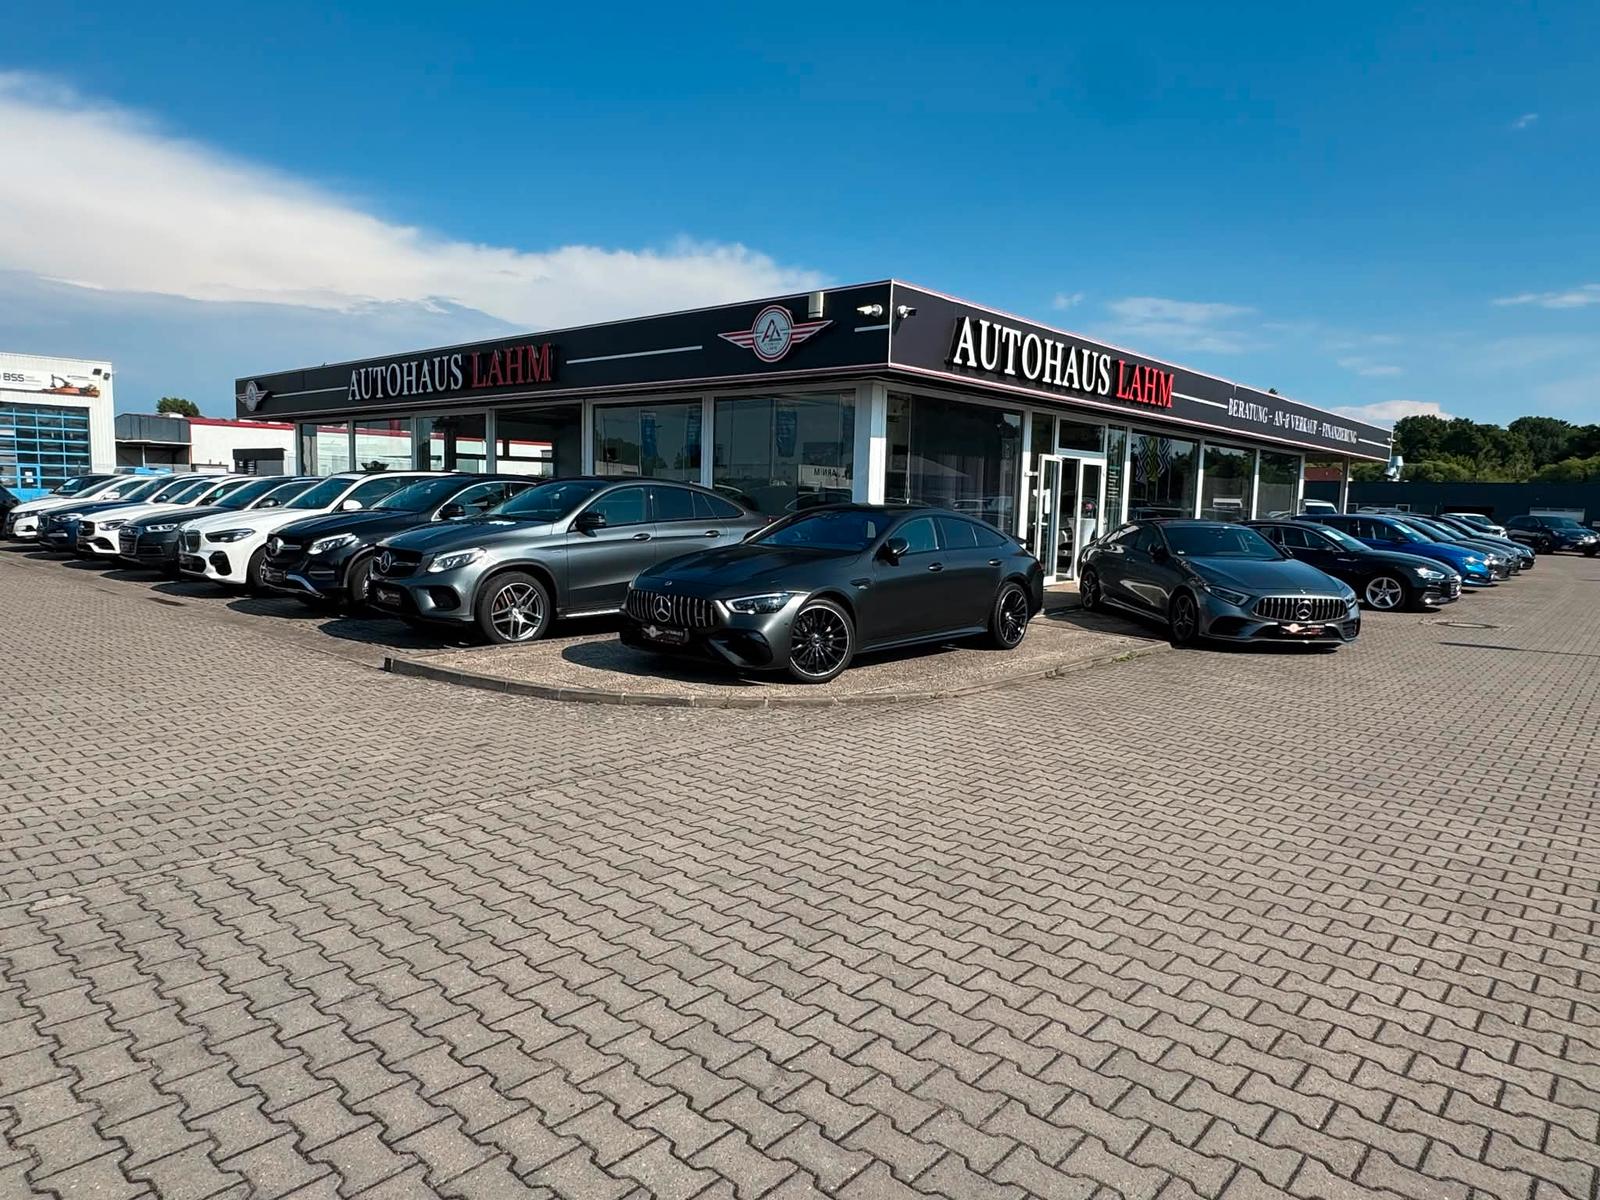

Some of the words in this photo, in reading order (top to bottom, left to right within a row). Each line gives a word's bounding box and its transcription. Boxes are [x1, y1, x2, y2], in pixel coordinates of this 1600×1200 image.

[3, 372, 25, 382] BSS
[348, 354, 462, 401] AUTOHAUS
[471, 342, 552, 388] LAHM
[953, 316, 1111, 395] AUTOHAUS
[1116, 360, 1175, 408] LAHM
[1228, 398, 1268, 424] BERATUNG
[1291, 414, 1318, 434] VERKAUF
[1322, 423, 1357, 444] FINANZIERUNG
